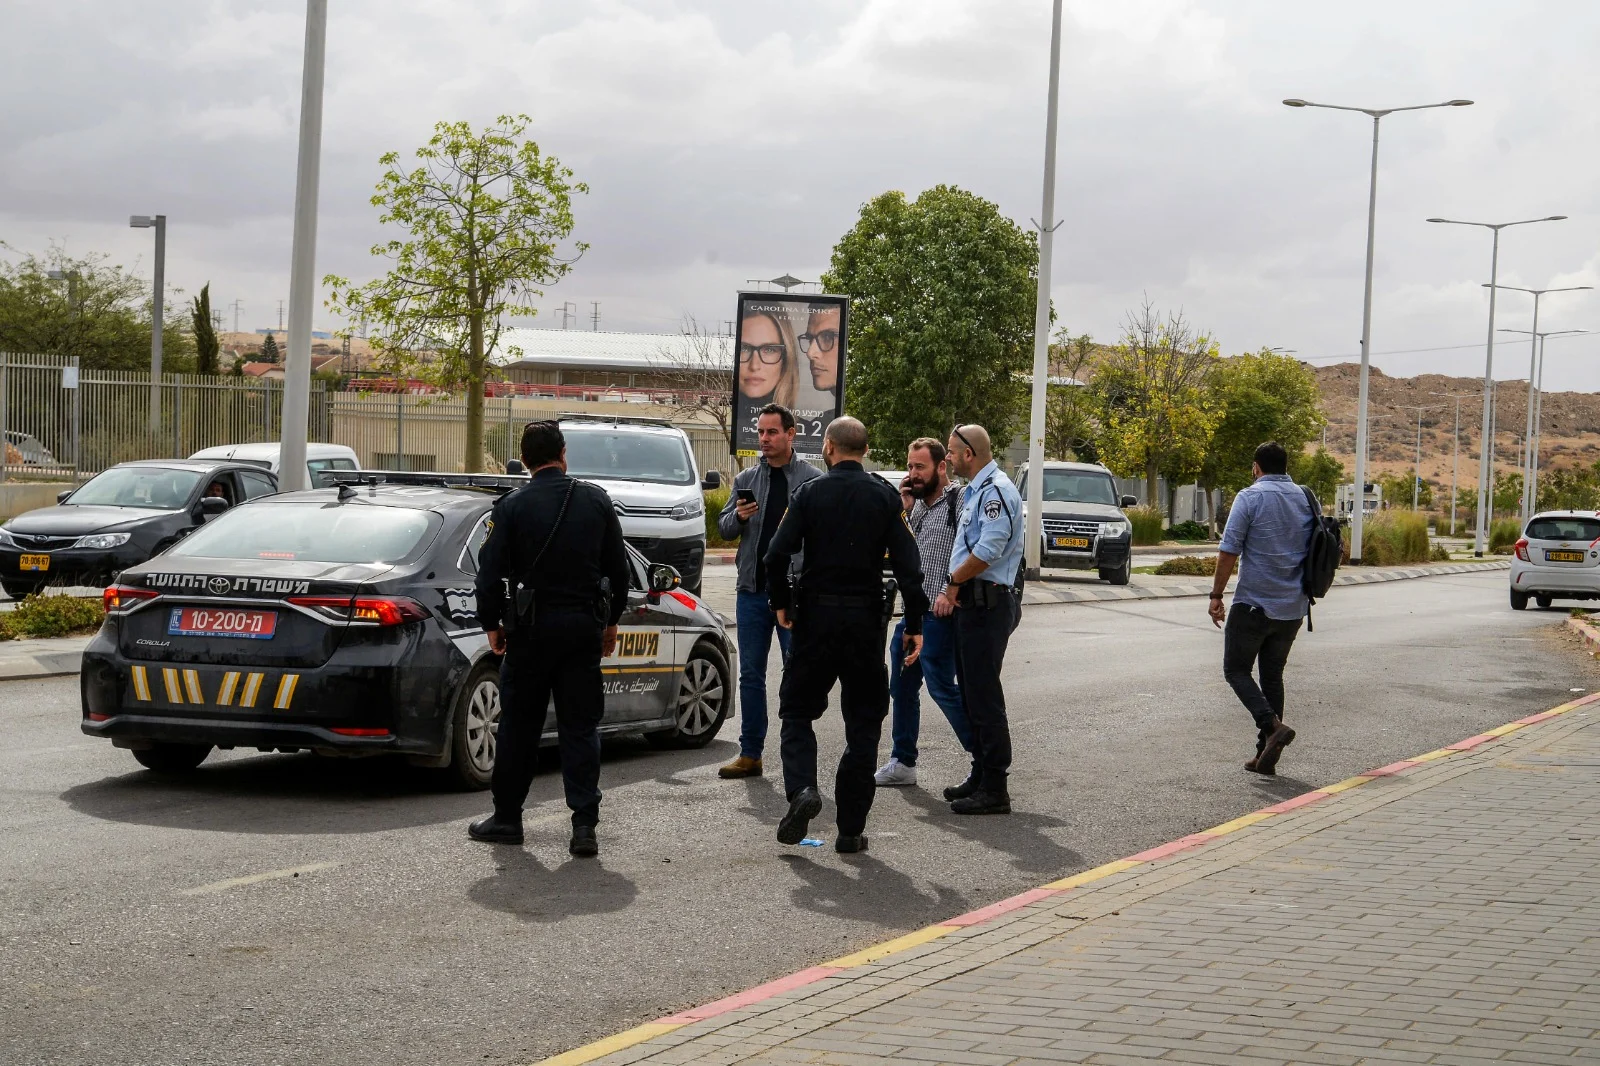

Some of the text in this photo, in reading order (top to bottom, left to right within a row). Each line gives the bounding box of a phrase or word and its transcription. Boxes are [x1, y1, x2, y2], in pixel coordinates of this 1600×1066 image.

[750, 305, 799, 313] CAROLINA
[802, 409, 824, 418] מבצע
[811, 421, 822, 437] 2
[146, 573, 310, 594] משטרת התנועה
[136, 638, 171, 647] COROLLA
[616, 632, 660, 658] משטר
[629, 677, 660, 695] الشرطة
